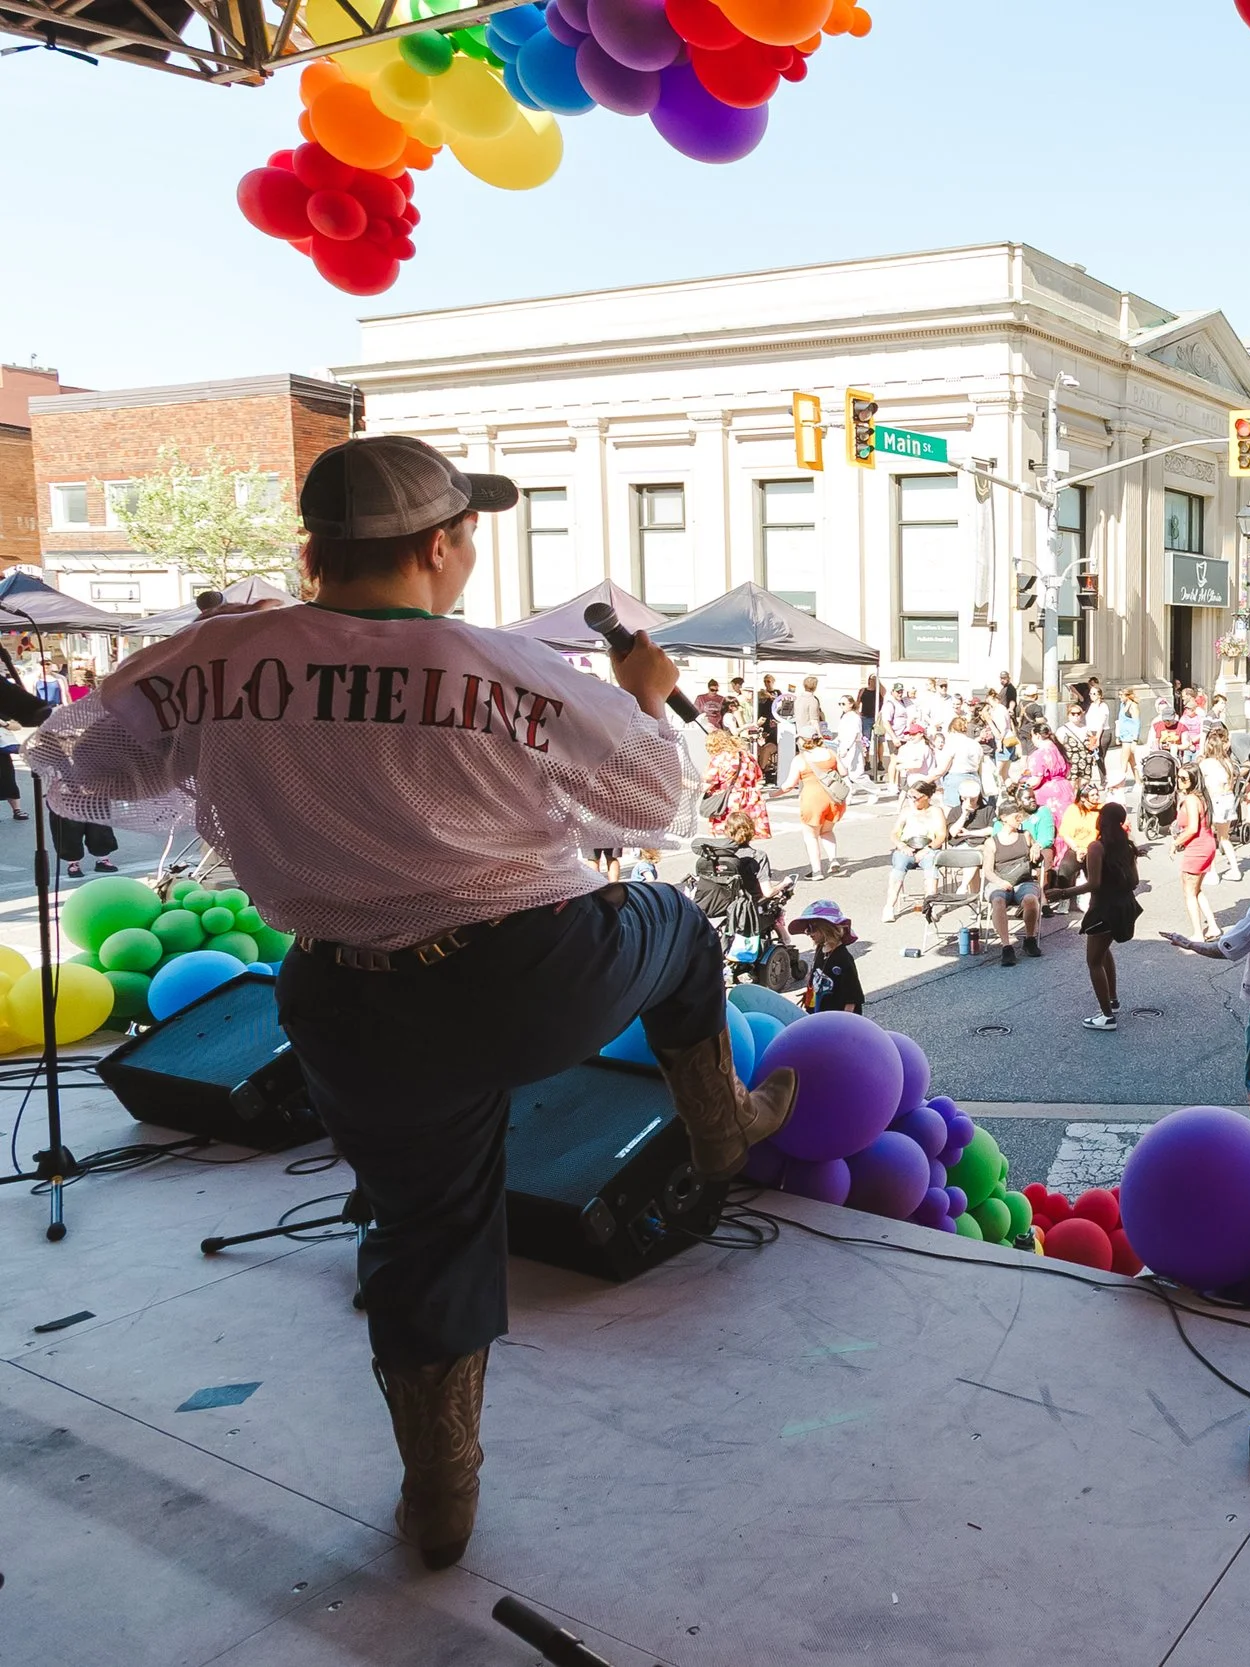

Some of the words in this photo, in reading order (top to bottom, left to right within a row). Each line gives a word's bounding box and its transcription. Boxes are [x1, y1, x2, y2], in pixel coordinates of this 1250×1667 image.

[1133, 385, 1162, 411] BANK
[1175, 402, 1190, 421] OF
[883, 431, 921, 456] Main
[922, 442, 934, 453] St.
[135, 657, 294, 733] BOLO
[306, 663, 410, 724] TIE
[418, 667, 563, 753] LINE
